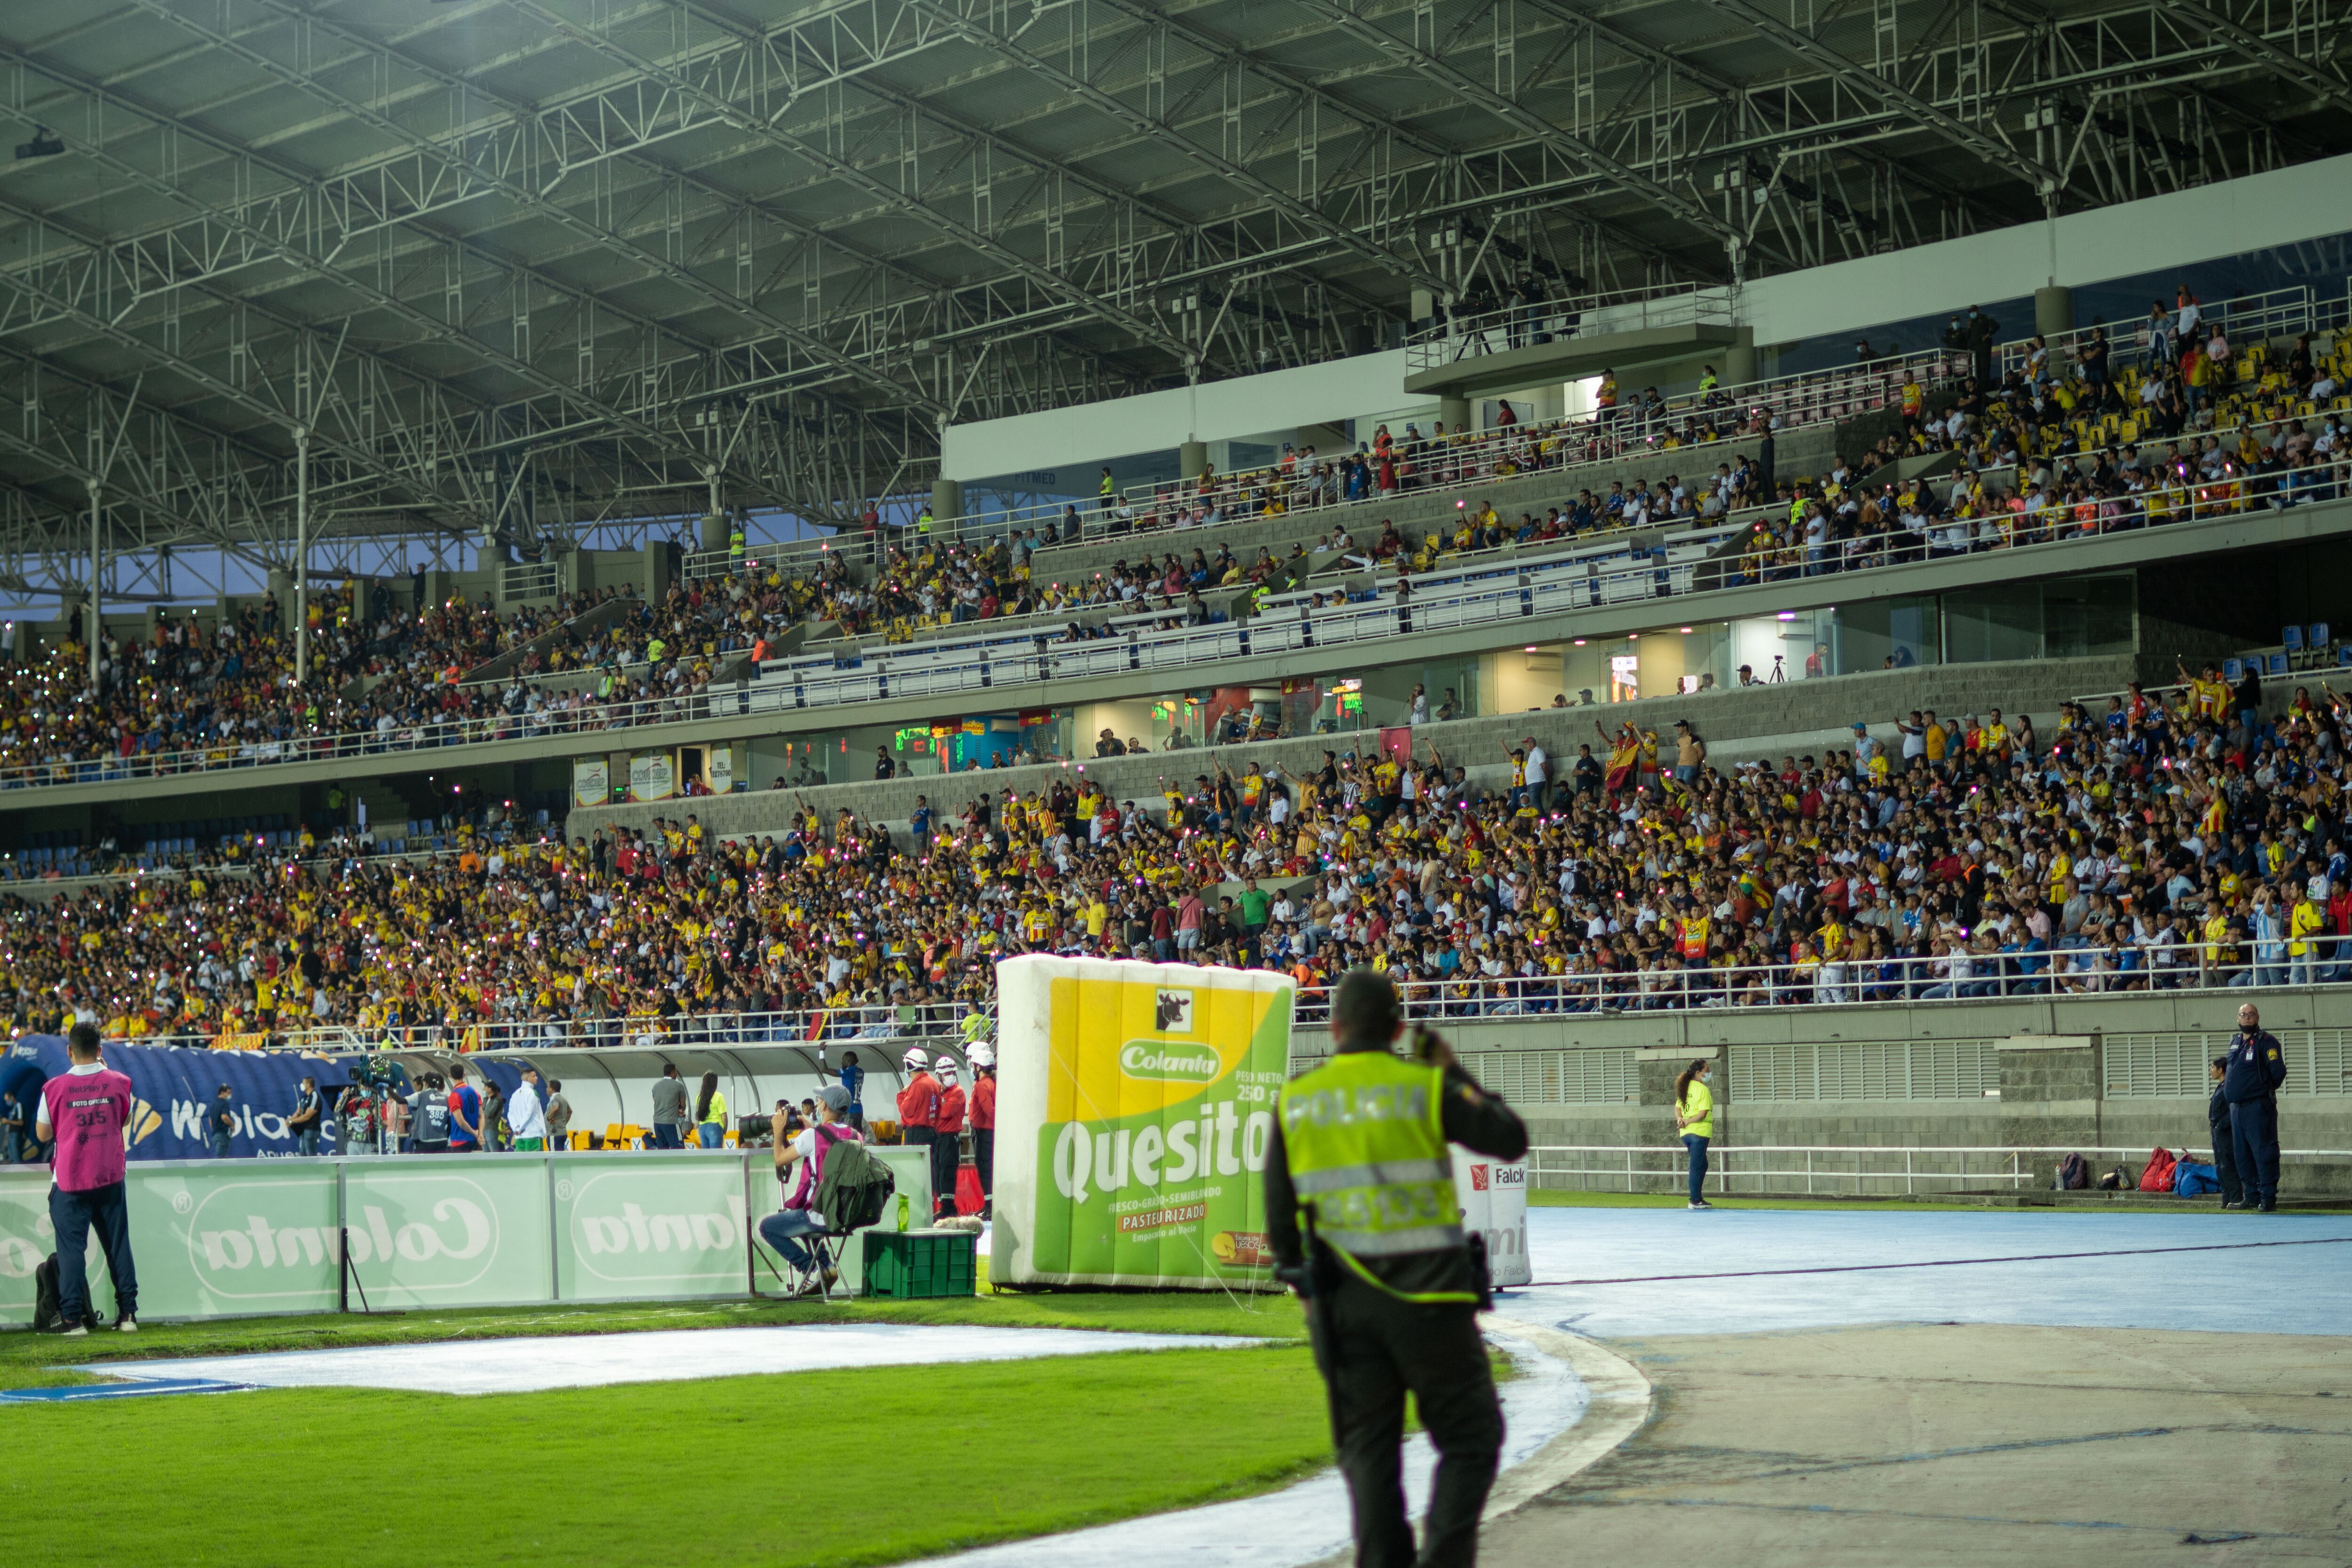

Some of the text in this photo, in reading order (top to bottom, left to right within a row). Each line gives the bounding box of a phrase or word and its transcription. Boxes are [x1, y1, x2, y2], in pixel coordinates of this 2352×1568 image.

[632, 768, 668, 781] CORDEP
[1122, 1046, 1217, 1074] Colanta
[1236, 1071, 1254, 1082] PESO
[1237, 1084, 1265, 1101] 250
[88, 1098, 110, 1106] OFICIAL
[1287, 1083, 1427, 1132] POLICIA
[76, 1111, 107, 1127] 315
[429, 1110, 445, 1120] 385
[1053, 1100, 1274, 1205] Quesito
[1496, 1168, 1525, 1184] Falck
[1122, 1204, 1205, 1231] PASTEURIZADO
[1133, 1229, 1166, 1243] Empacado
[1168, 1227, 1176, 1235] al
[1504, 1265, 1526, 1277] Falck
